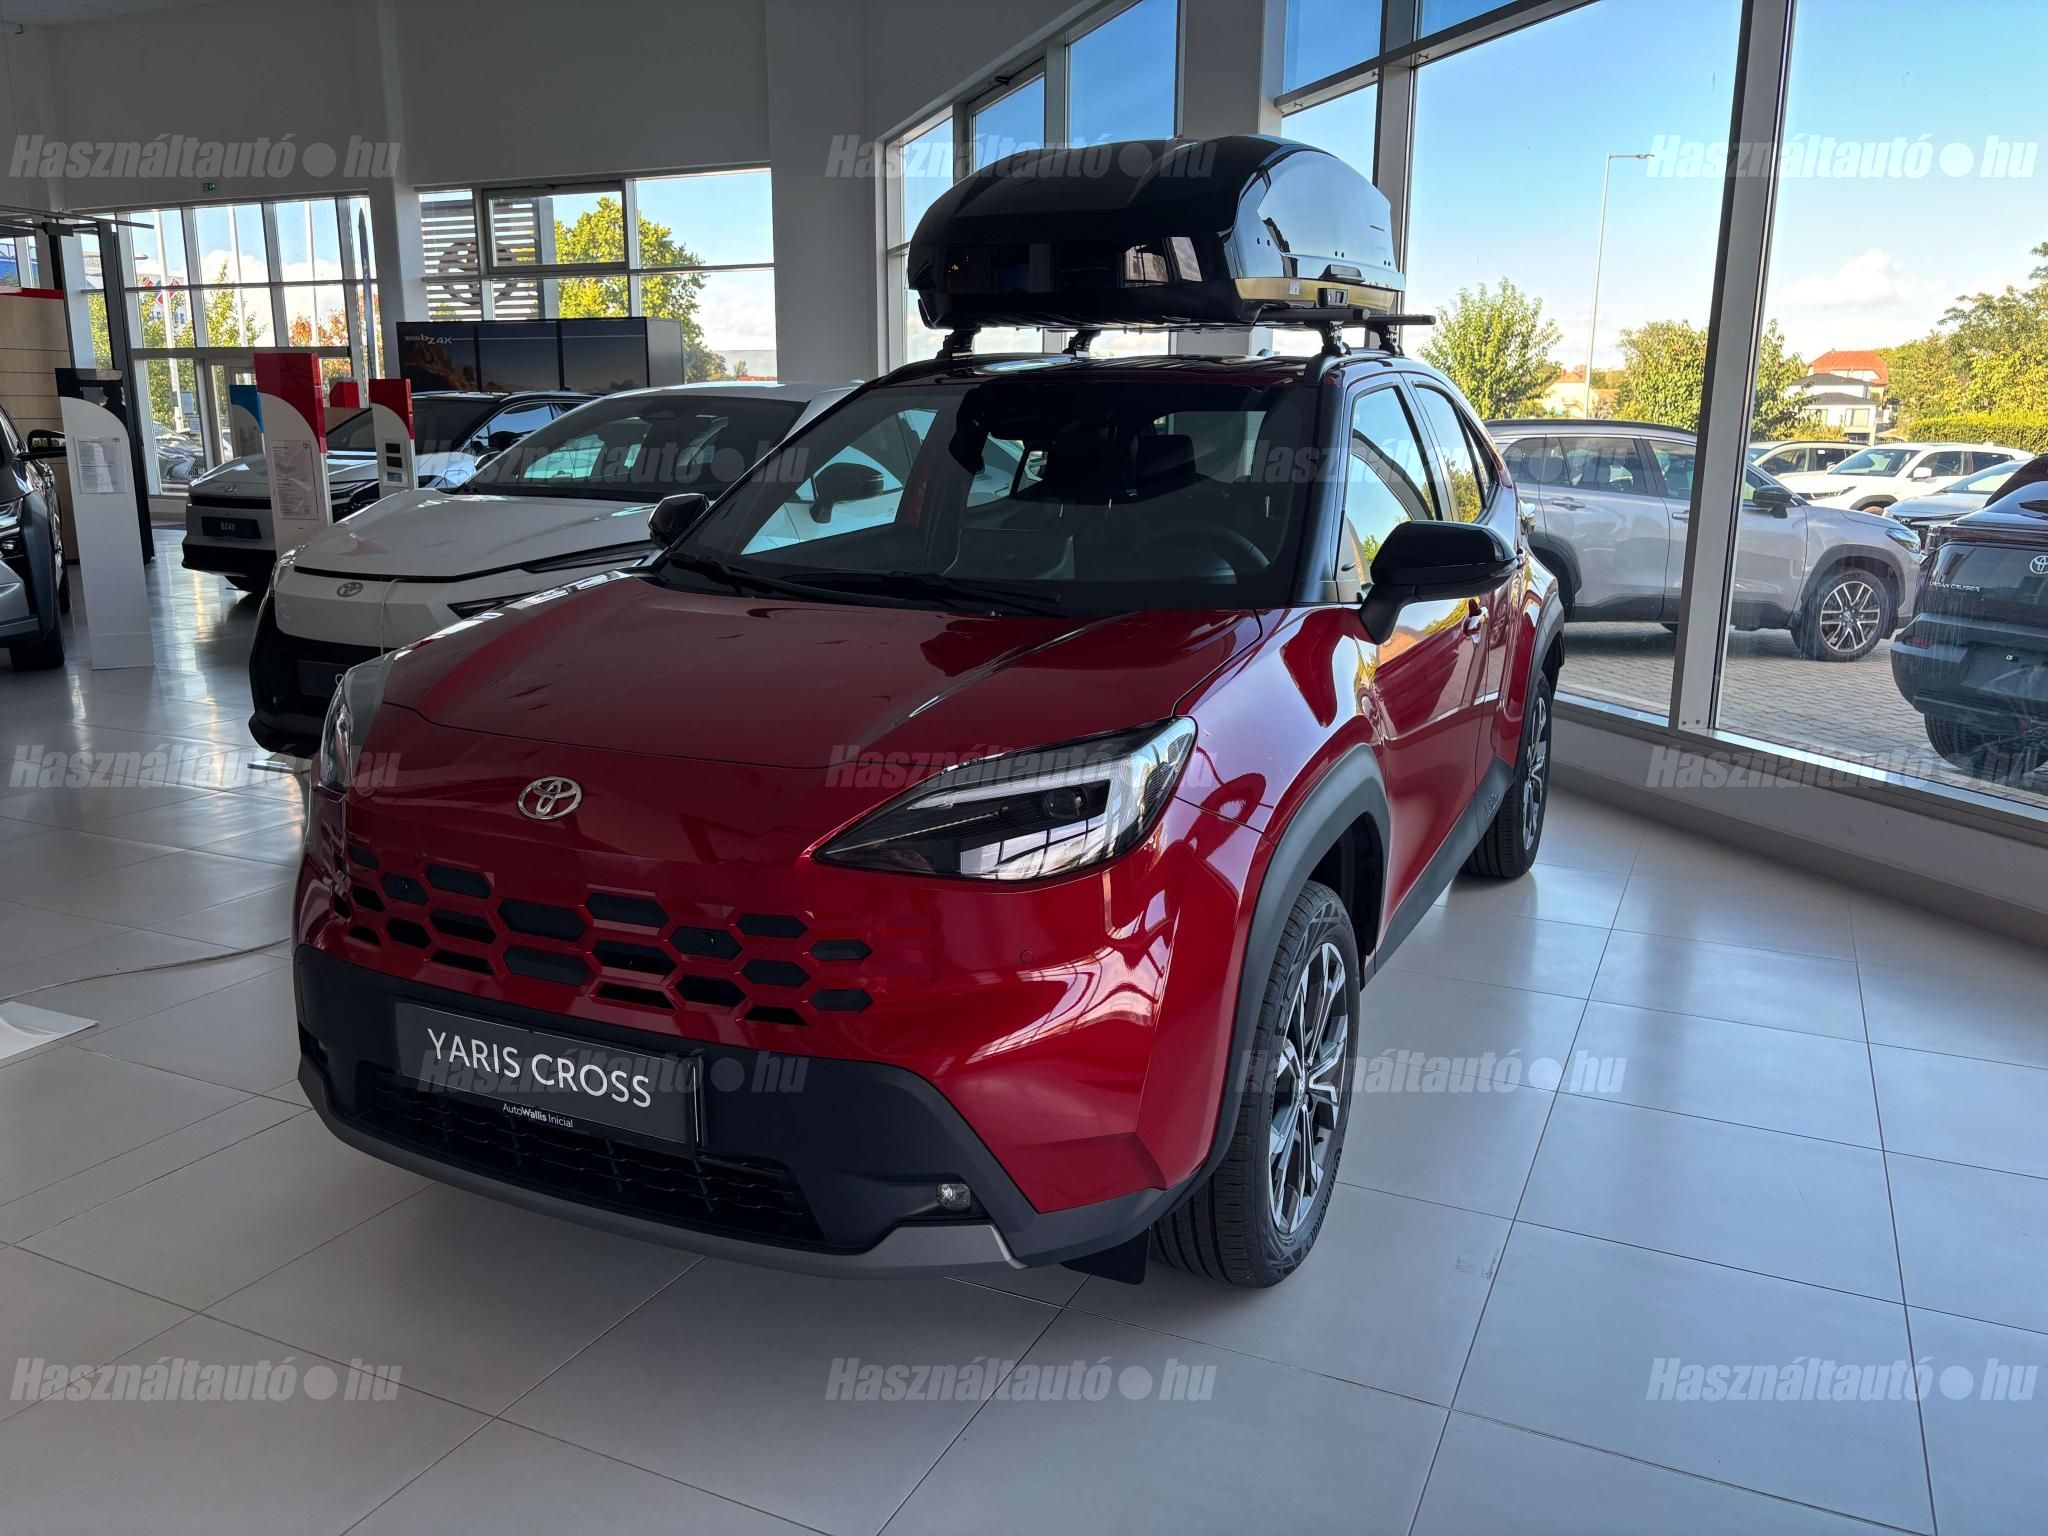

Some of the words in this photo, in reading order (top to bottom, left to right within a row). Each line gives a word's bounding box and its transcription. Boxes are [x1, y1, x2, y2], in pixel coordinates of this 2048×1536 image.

[1950, 583, 1980, 592] CRUISER
[426, 1028, 521, 1078] YARIS
[531, 1053, 651, 1108] CROSS
[502, 1103, 547, 1123] AutoWallis
[548, 1113, 574, 1128] Inicial
